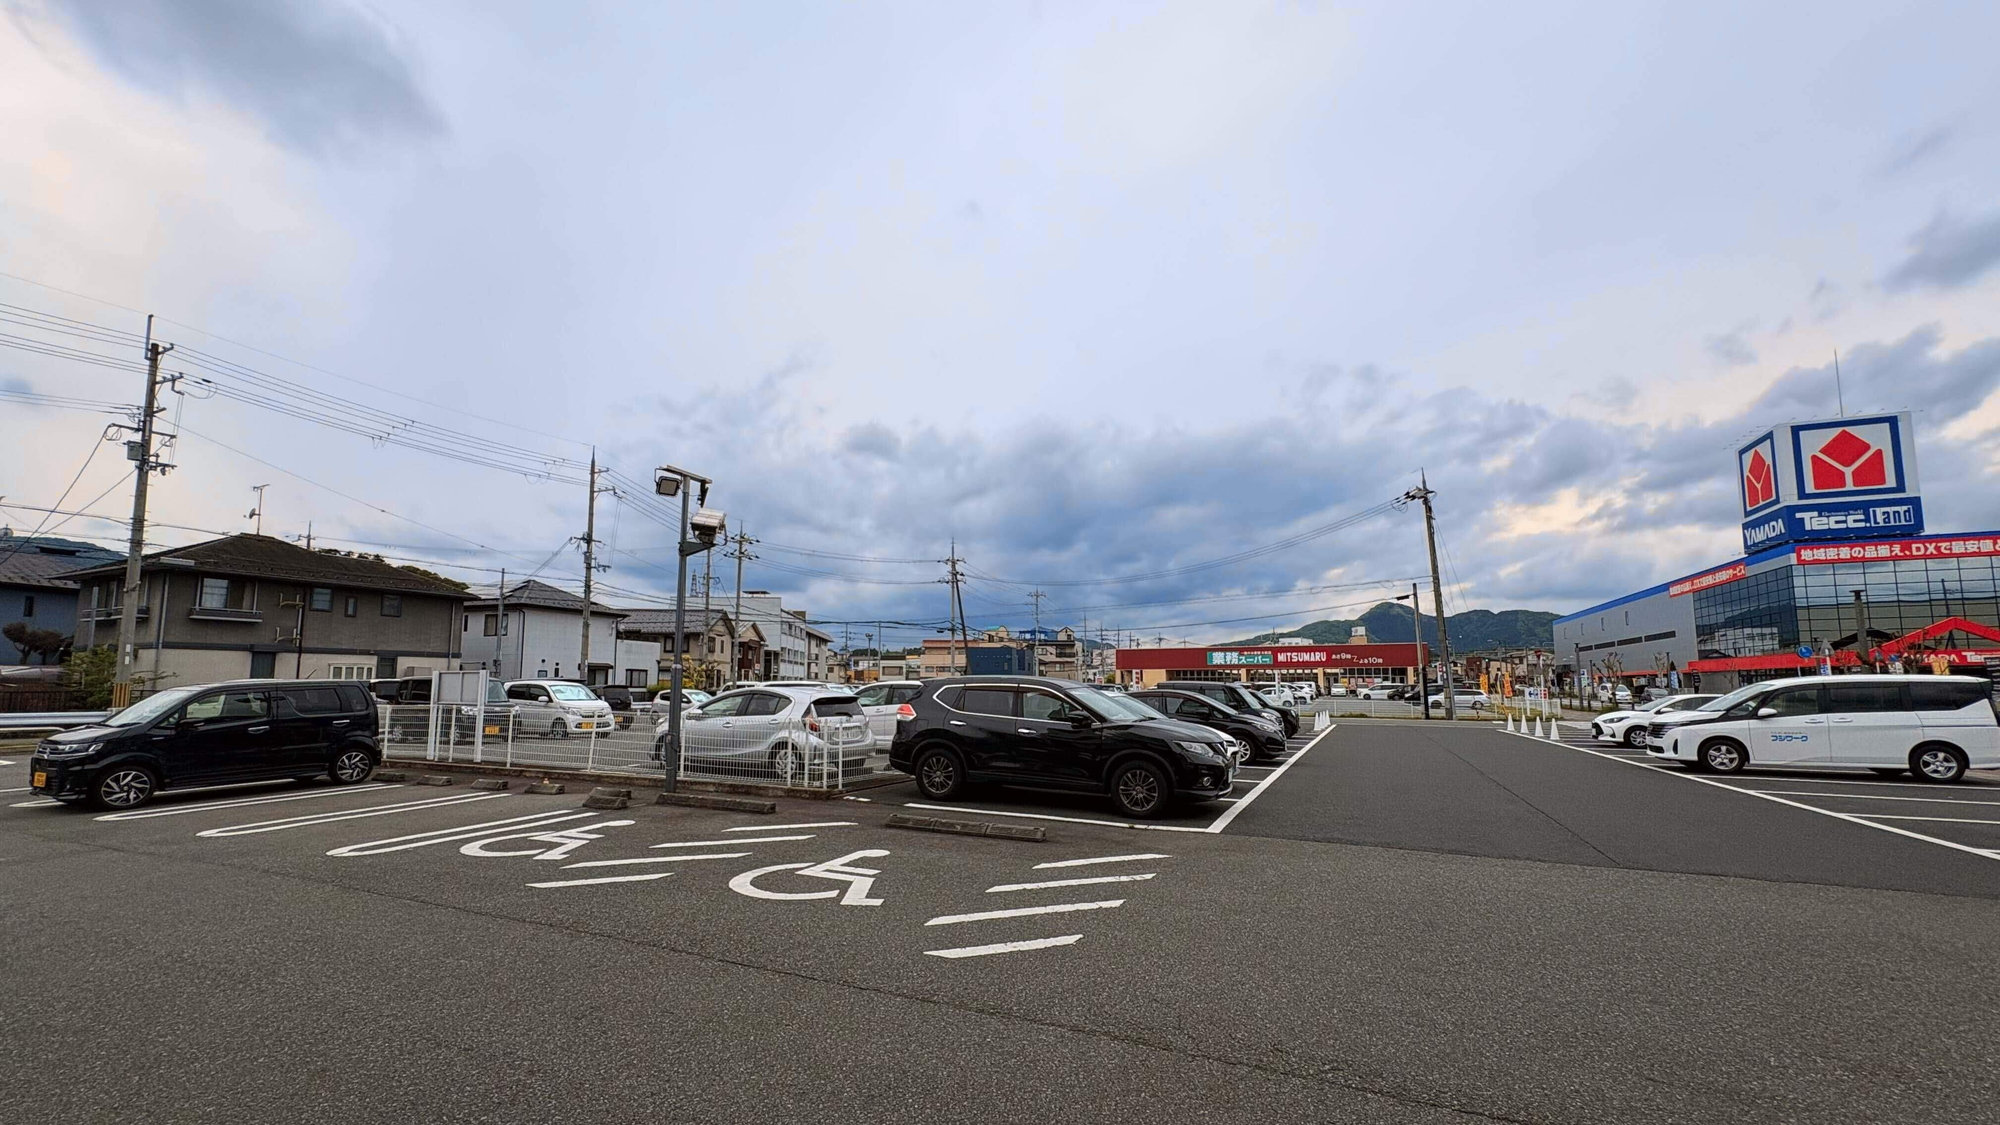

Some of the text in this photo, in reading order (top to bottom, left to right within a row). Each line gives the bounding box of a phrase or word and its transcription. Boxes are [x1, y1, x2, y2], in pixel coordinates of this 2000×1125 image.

[1744, 518, 1786, 545] YAMADA
[1212, 652, 1271, 665] 業務スーパー
[1277, 651, 1327, 663] MITSUMARU
